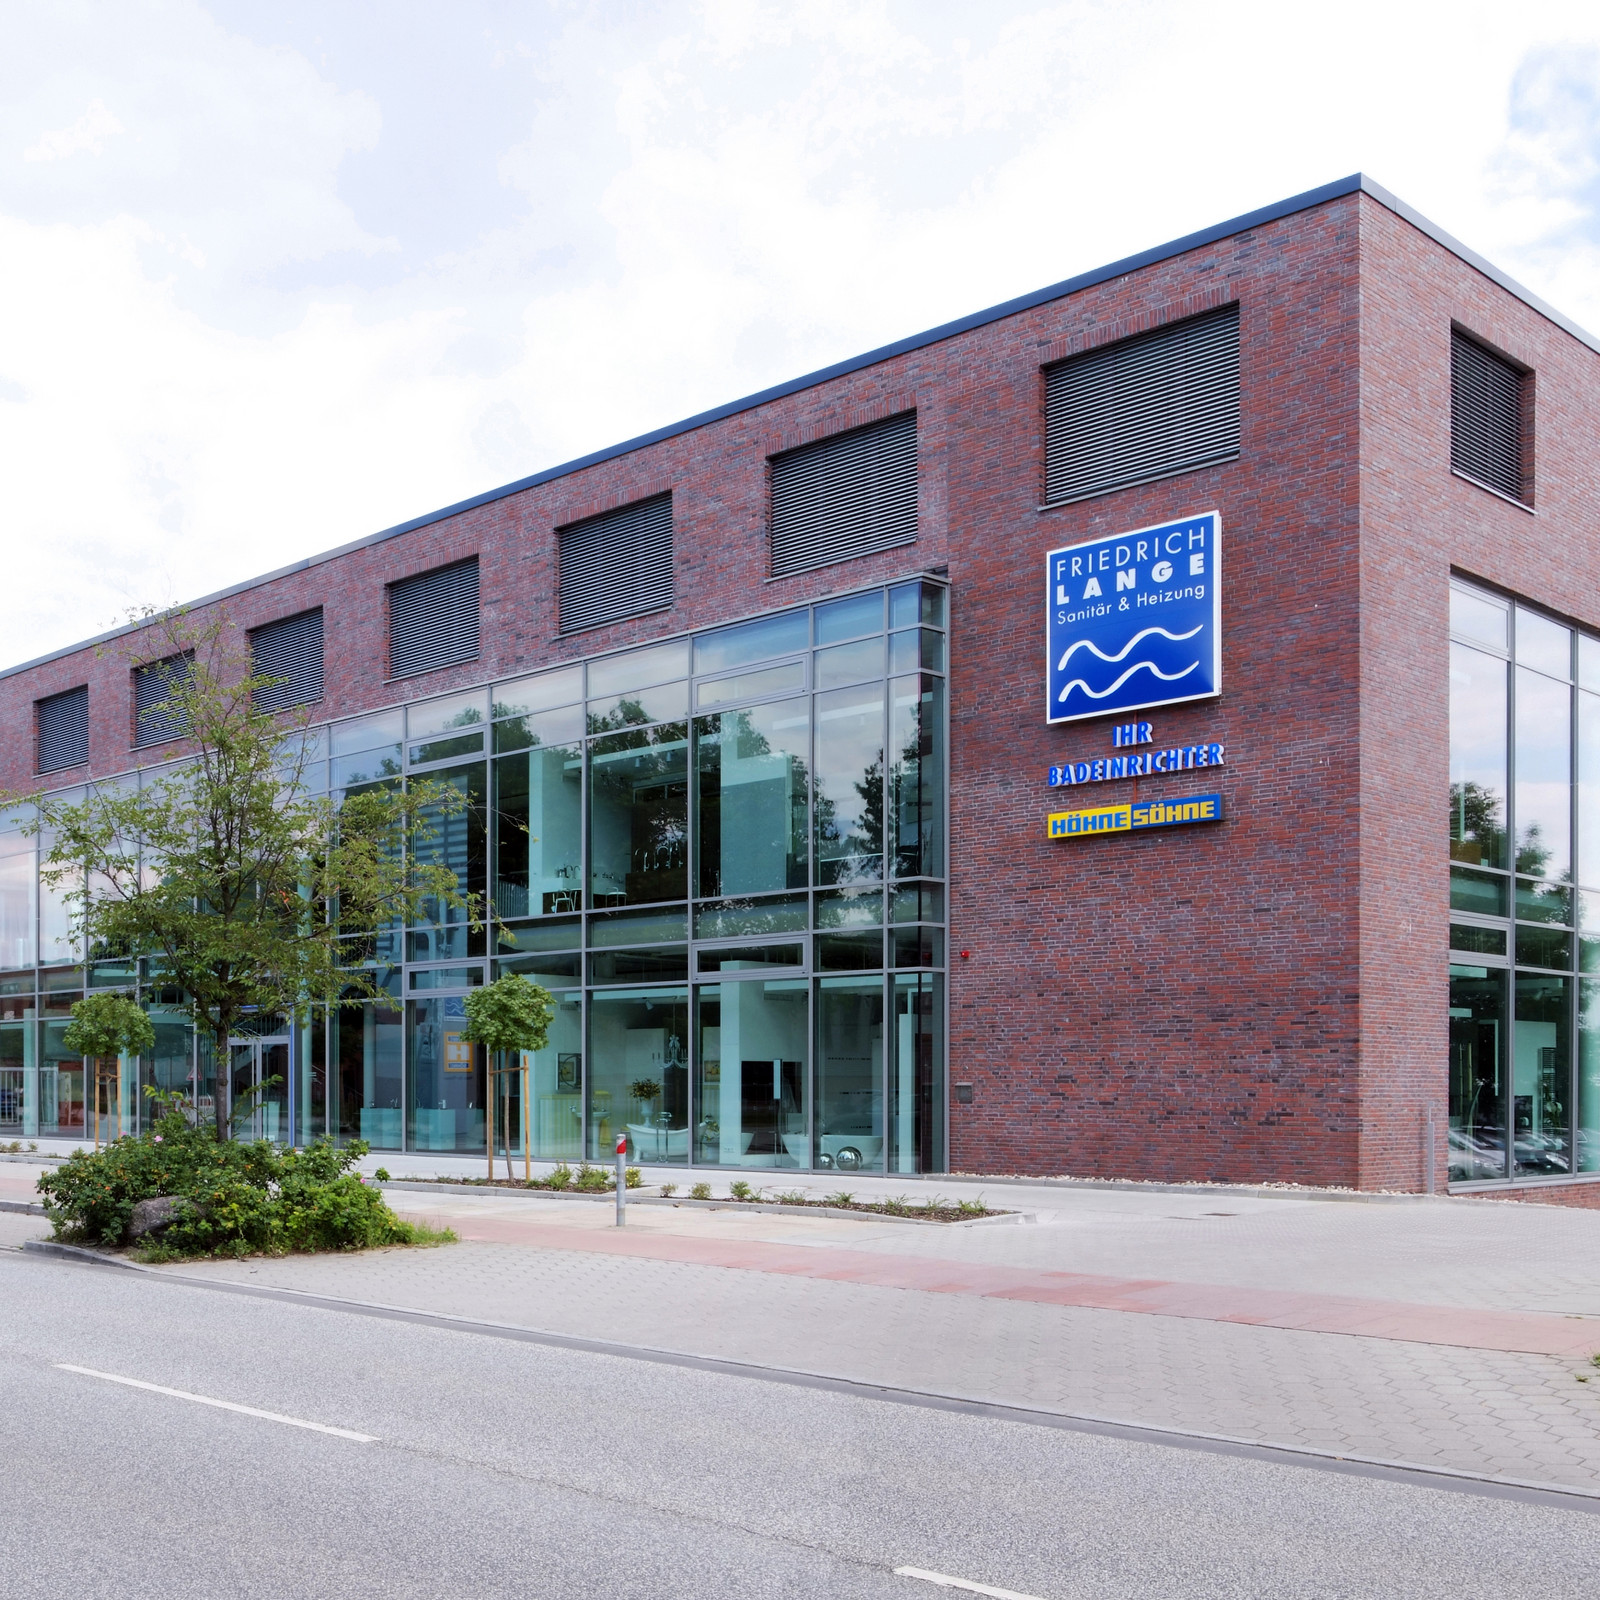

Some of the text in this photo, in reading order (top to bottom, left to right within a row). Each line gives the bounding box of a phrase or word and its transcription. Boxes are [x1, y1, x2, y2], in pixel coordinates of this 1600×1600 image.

[1057, 526, 1205, 580] FRIEDRICH
[1057, 552, 1205, 606] LANGE
[1057, 585, 1205, 625] Sanitär & Heizung
[1112, 721, 1153, 747] IHR
[1048, 743, 1225, 787] BADEINRICHTER
